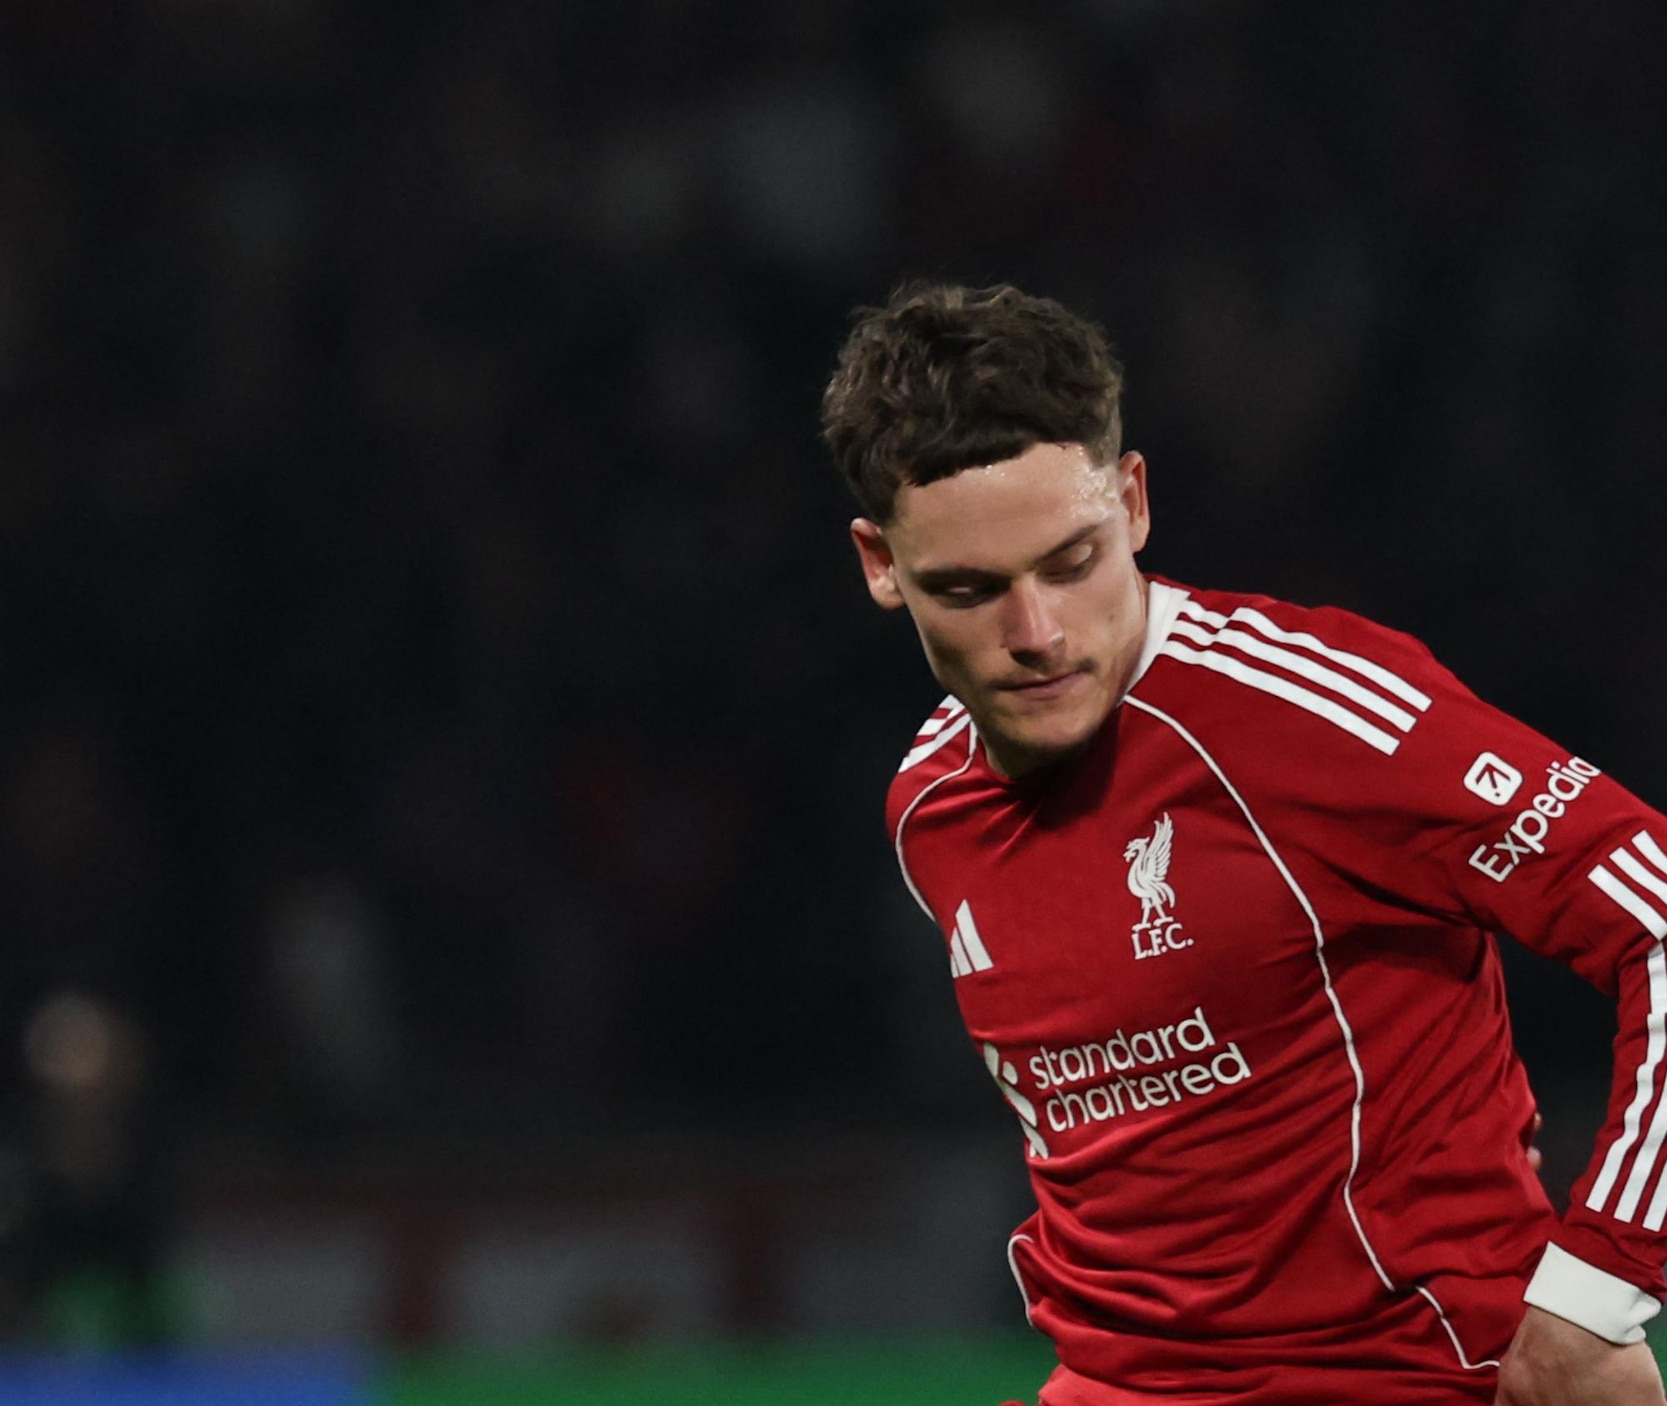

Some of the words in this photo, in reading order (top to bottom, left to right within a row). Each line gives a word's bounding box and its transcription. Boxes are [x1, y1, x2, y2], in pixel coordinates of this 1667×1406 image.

[1468, 756, 1601, 883] Expedia
[1029, 1006, 1215, 1090] standard
[1046, 1042, 1252, 1132] chartered
